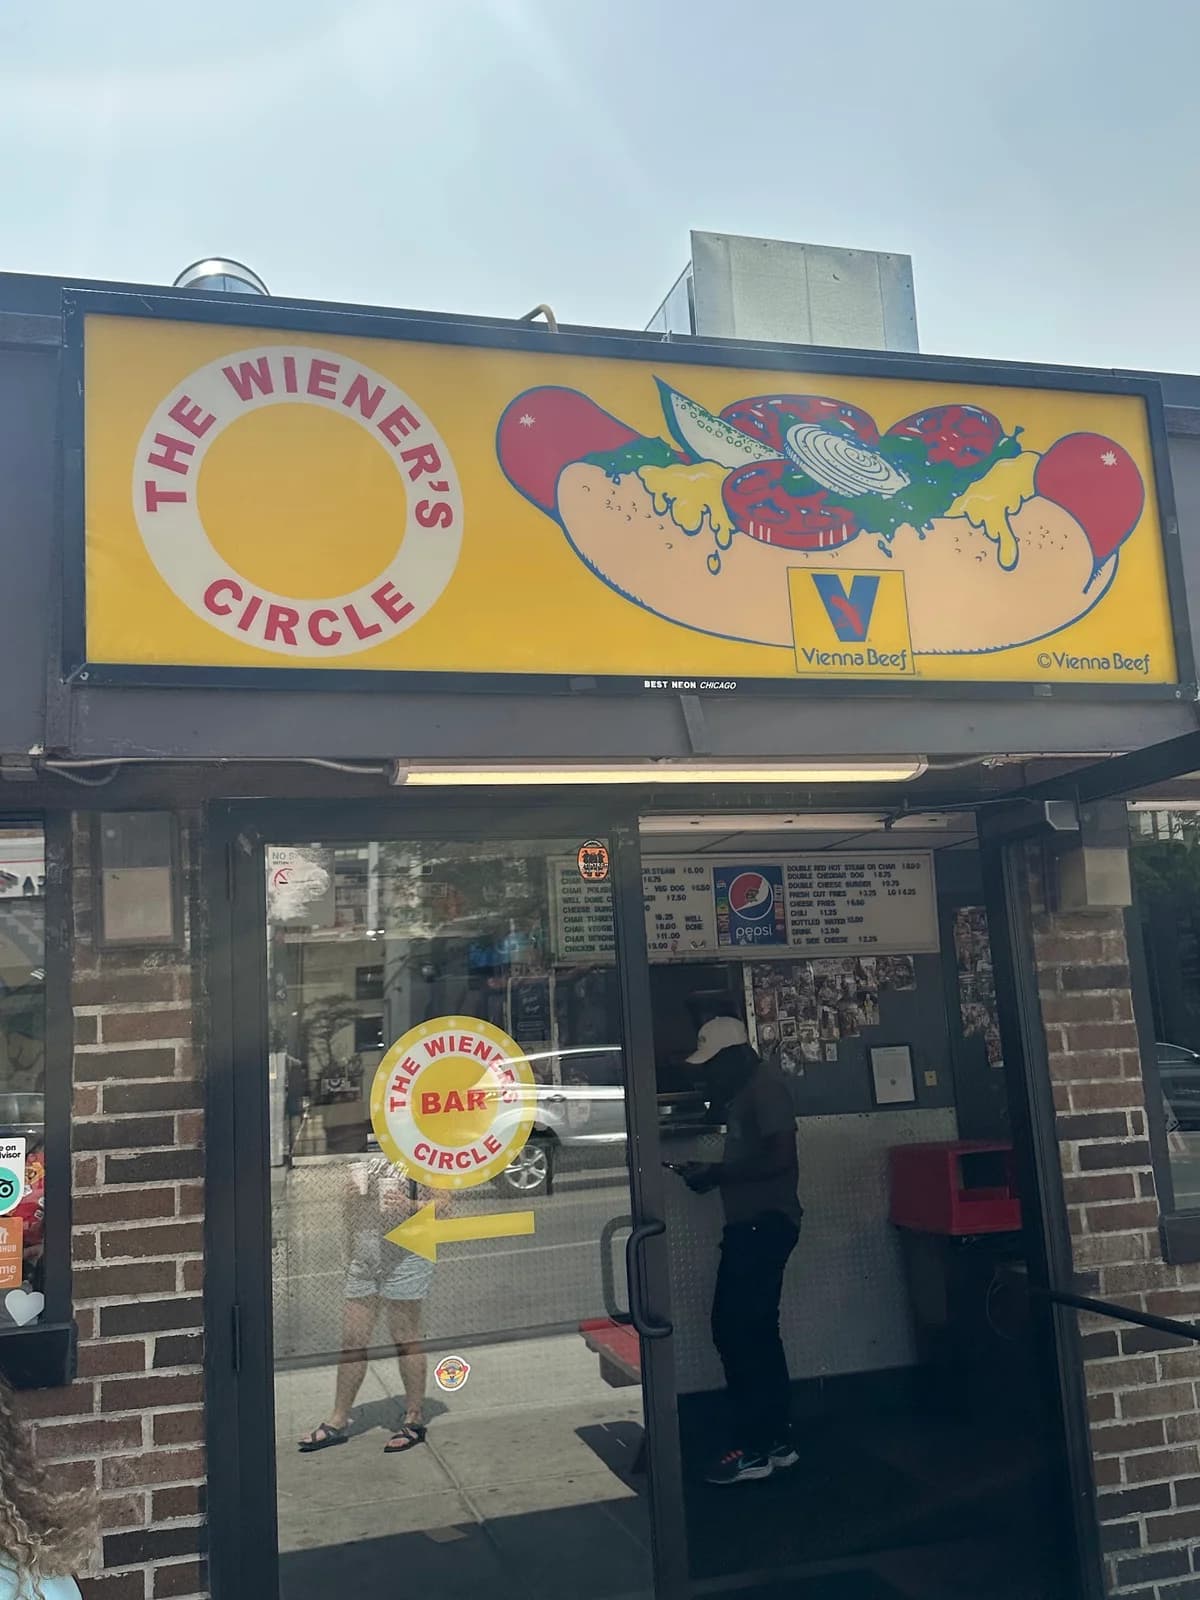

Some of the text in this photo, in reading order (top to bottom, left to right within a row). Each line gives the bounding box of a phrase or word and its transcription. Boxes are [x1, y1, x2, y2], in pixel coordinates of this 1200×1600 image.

[145, 356, 453, 528] THE WIENER'S
[204, 579, 415, 647] CIRCLE
[801, 647, 907, 670] Vienna Beef
[1112, 654, 1151, 675] Beef
[644, 680, 737, 689] BEST NEON CHICAGO
[787, 864, 811, 872] DOUBLE
[814, 864, 827, 872] RED
[828, 863, 841, 871] HOT
[670, 884, 685, 892] DOG
[562, 896, 581, 904] WELL
[817, 899, 836, 907] FRIES
[790, 909, 807, 917] CHILI
[791, 918, 820, 926] BOTTLED
[735, 923, 773, 939] pepsi
[824, 936, 848, 944] CHEESE
[389, 1056, 421, 1113] THE
[421, 1089, 488, 1115] BAR
[5, 1144, 17, 1152] on
[413, 1134, 503, 1170] CIRCLE
